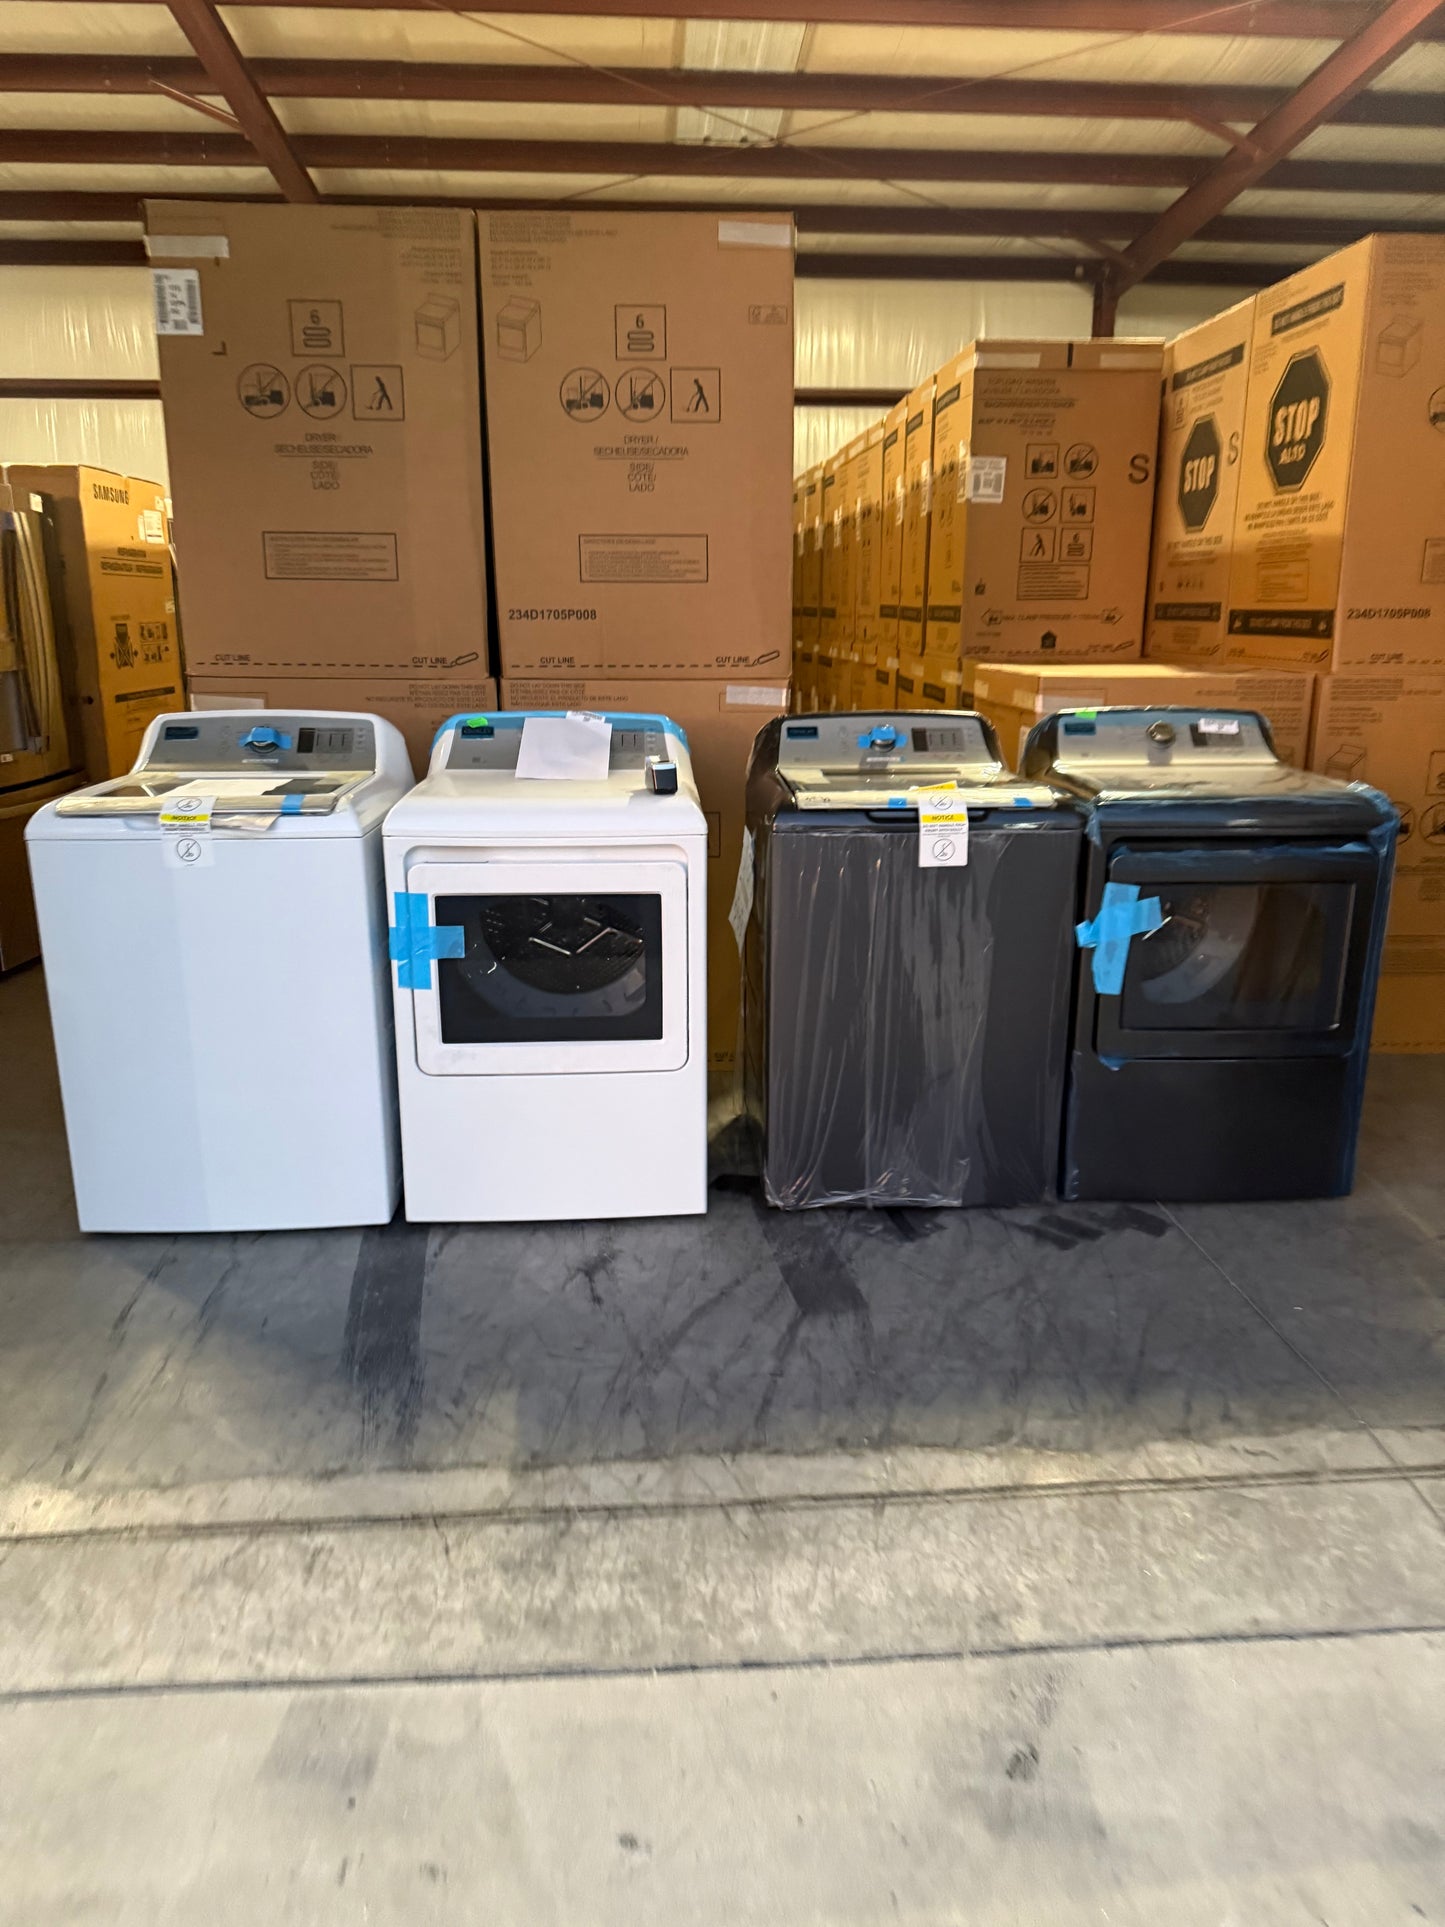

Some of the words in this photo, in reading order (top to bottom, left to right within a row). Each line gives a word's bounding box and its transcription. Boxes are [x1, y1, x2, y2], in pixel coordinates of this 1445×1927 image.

[635, 313, 645, 329] 6
[1272, 396, 1320, 447] STOP
[1128, 453, 1150, 485] S
[1183, 454, 1216, 495] STOP
[93, 483, 130, 505] SAMSUNG
[508, 609, 597, 621] 234D1705P008
[412, 656, 428, 664] CUT
[430, 656, 448, 665] LINE
[540, 656, 556, 664] CUT
[558, 656, 575, 665] LINE
[715, 655, 731, 663] CUT
[733, 655, 750, 664] LINE
